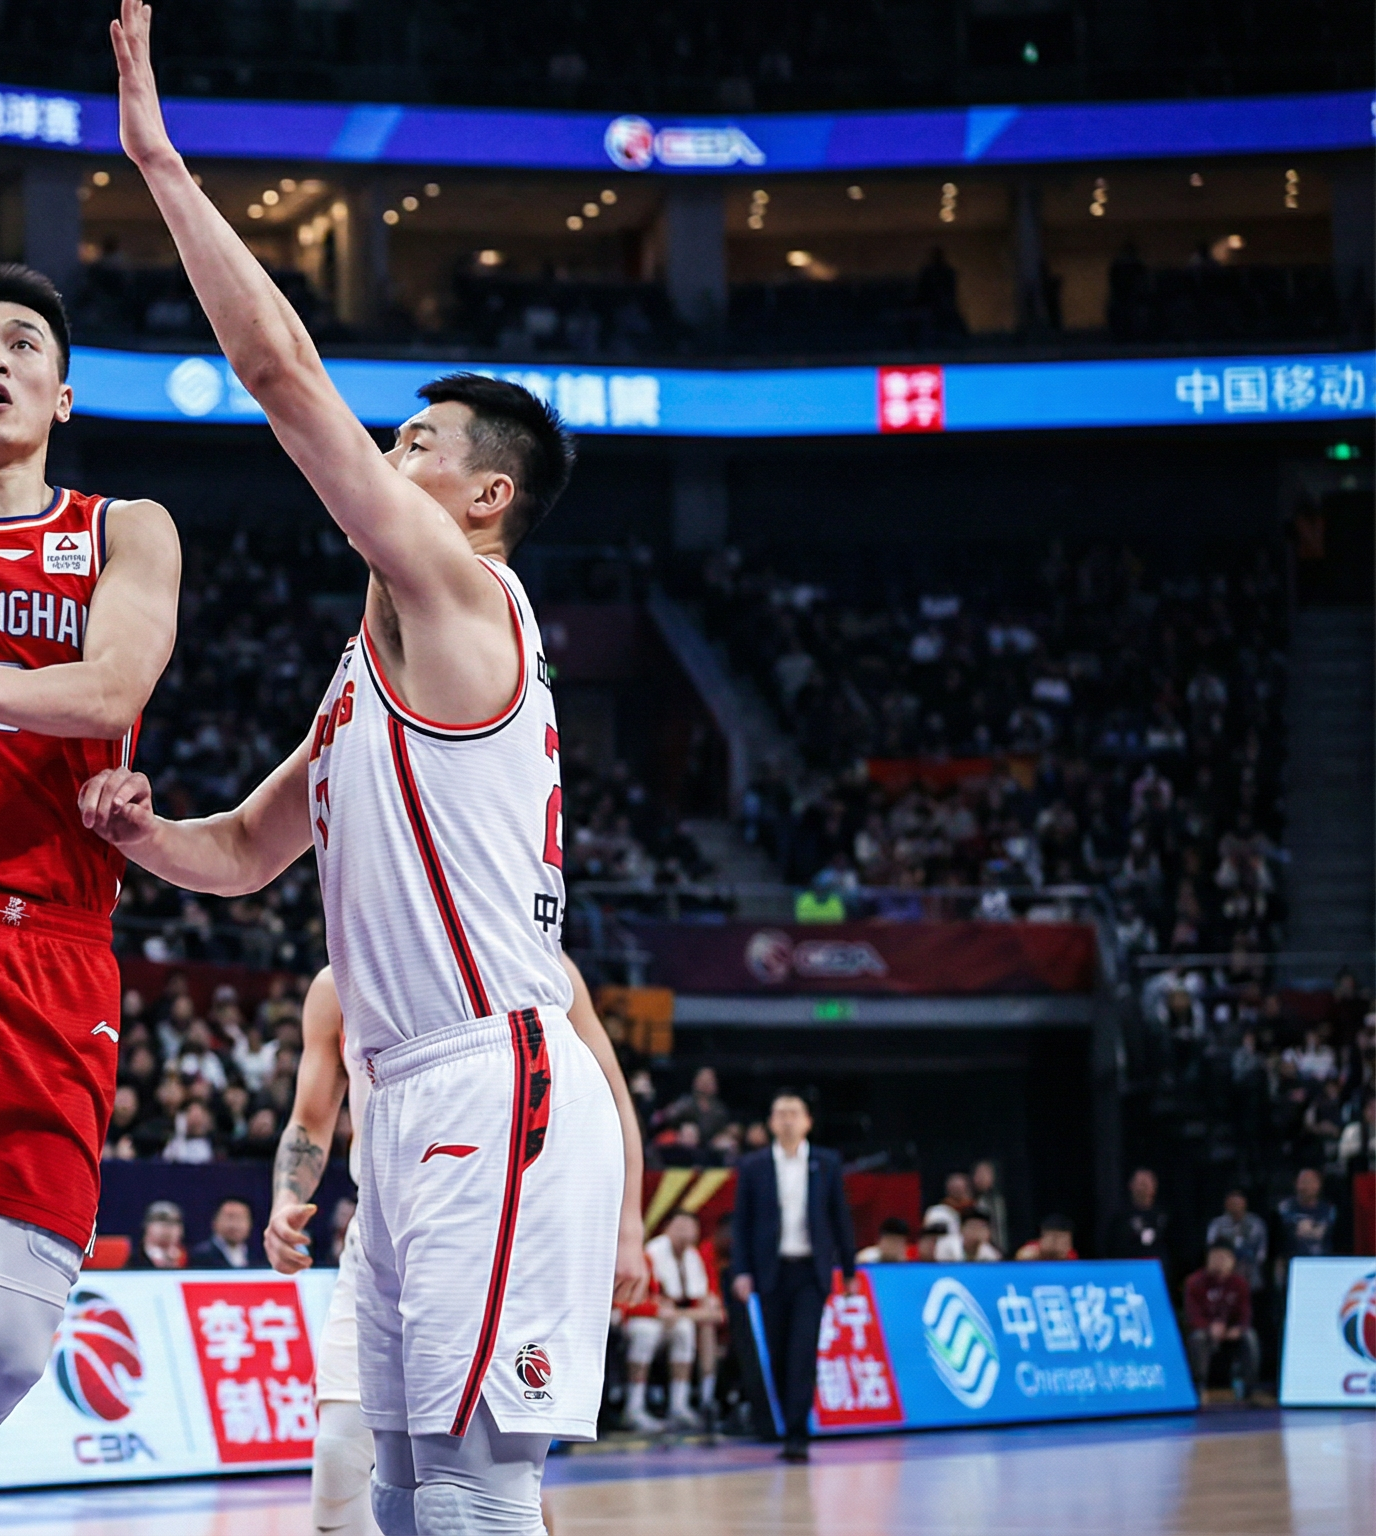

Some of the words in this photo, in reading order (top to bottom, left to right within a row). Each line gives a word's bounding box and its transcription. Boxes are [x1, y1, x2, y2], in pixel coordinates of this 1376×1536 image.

[1176, 363, 1365, 415] 中国移动
[534, 893, 565, 941] 中
[997, 1282, 1155, 1353] 中国移动
[1343, 1372, 1376, 1396] C
[74, 1432, 158, 1464] CBA
